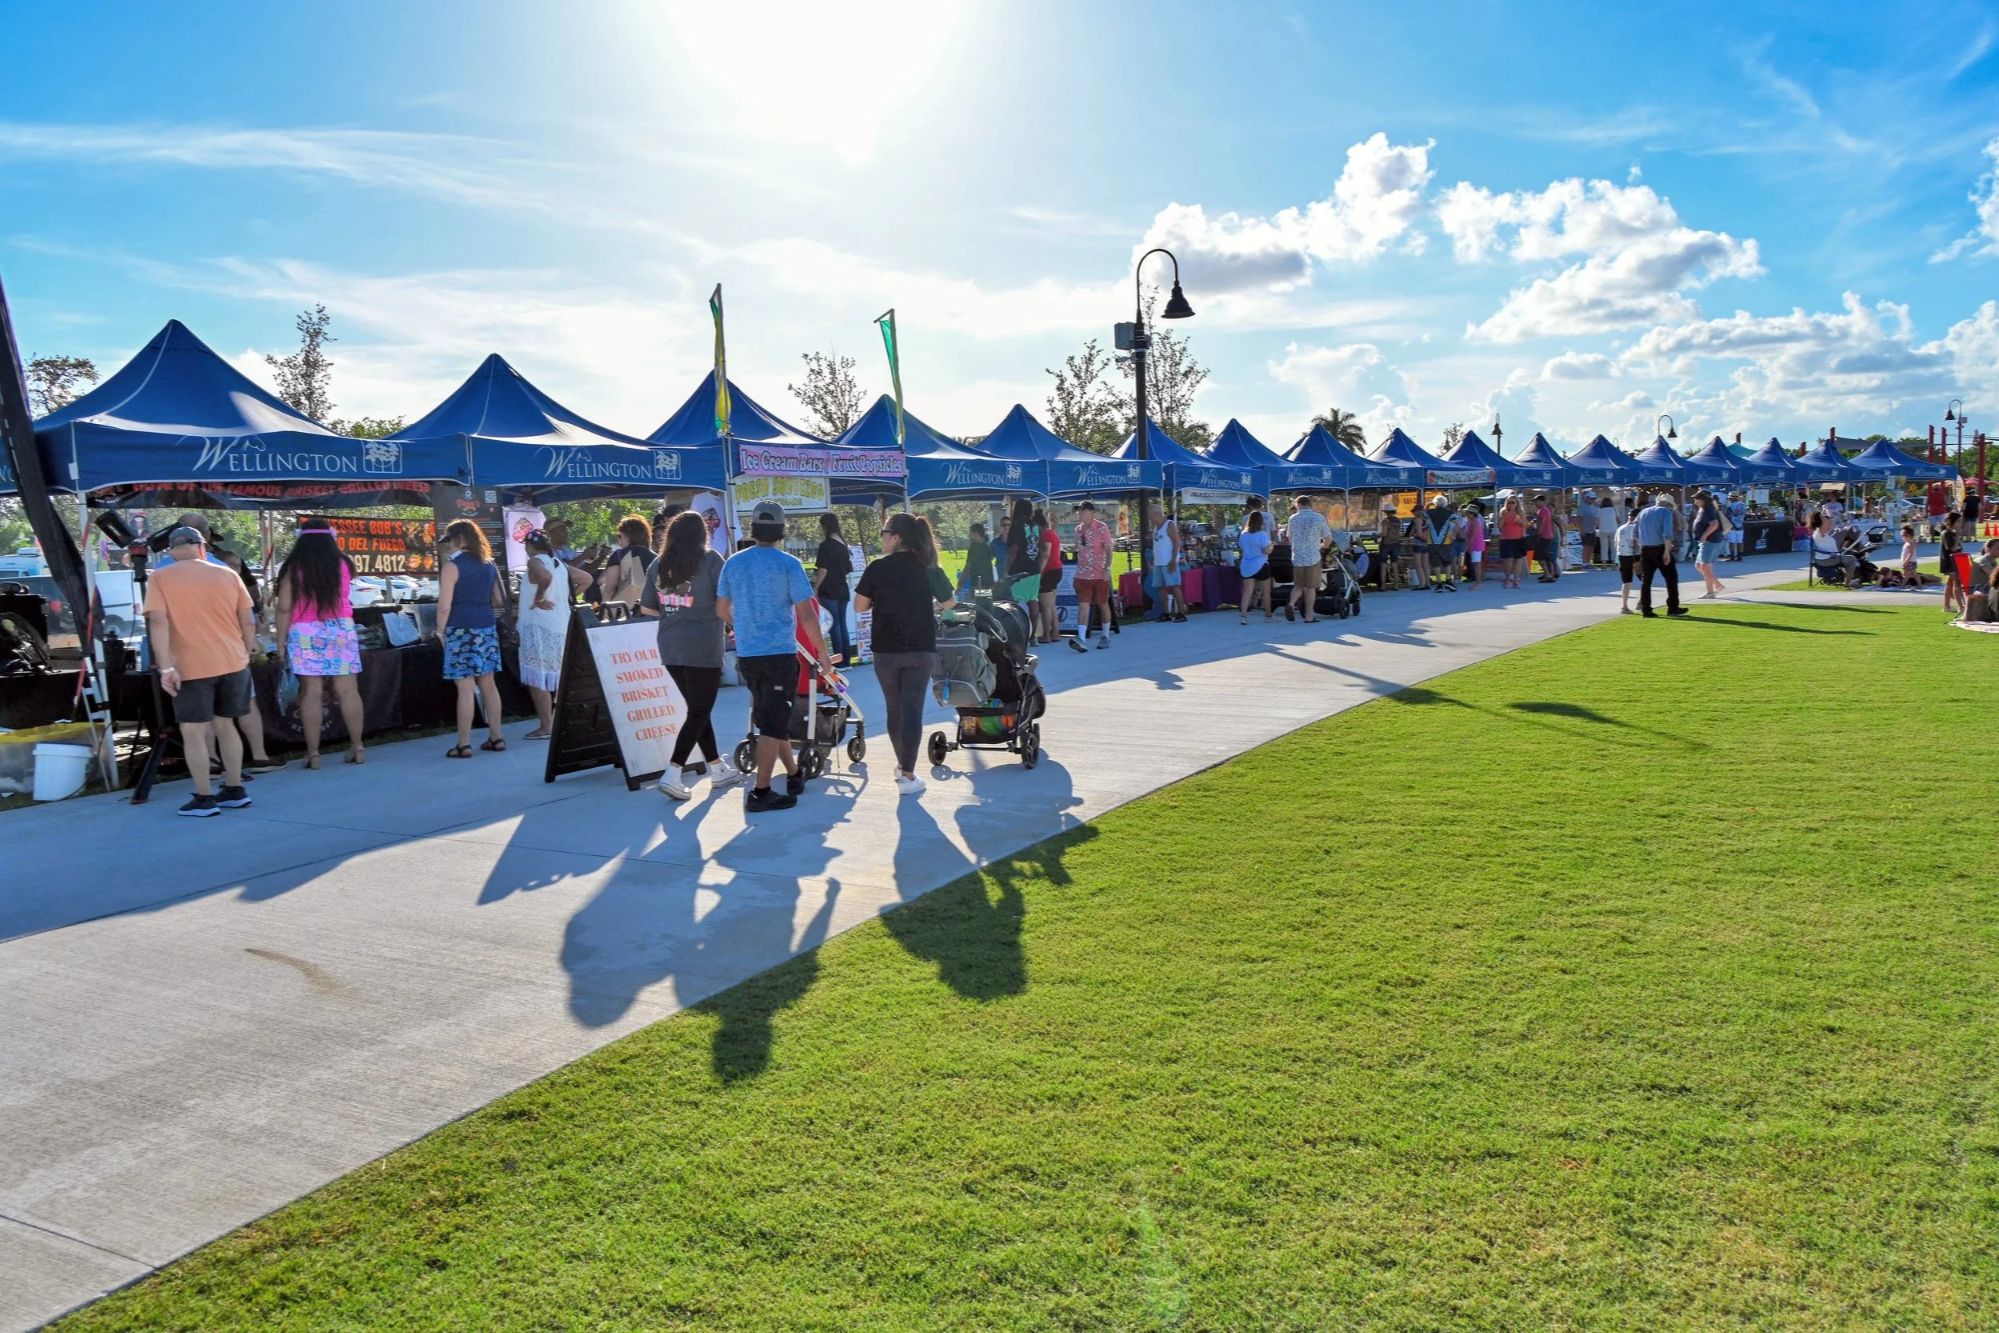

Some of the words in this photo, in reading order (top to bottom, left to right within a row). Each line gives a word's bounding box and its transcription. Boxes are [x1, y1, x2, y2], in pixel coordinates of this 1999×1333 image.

[189, 436, 358, 473] WELLINGTON
[541, 446, 651, 479] WELLINGTON
[741, 449, 760, 471] Ice
[760, 450, 799, 472] Cream
[799, 452, 824, 474] Bars
[832, 454, 859, 474] Fruit
[859, 454, 905, 476] Popsicles
[943, 462, 1004, 486] WELLINGTON
[1074, 464, 1127, 487] WELLINGTON
[369, 520, 403, 535] BOB'S
[348, 537, 369, 552] DEL
[371, 538, 406, 552] FUEGO
[609, 651, 633, 665] TRY
[634, 648, 658, 661] OUR
[615, 667, 664, 684] SMOKED
[621, 685, 669, 704] BRISKET
[626, 703, 676, 723] GRILLED
[635, 723, 678, 742] CHEESE
